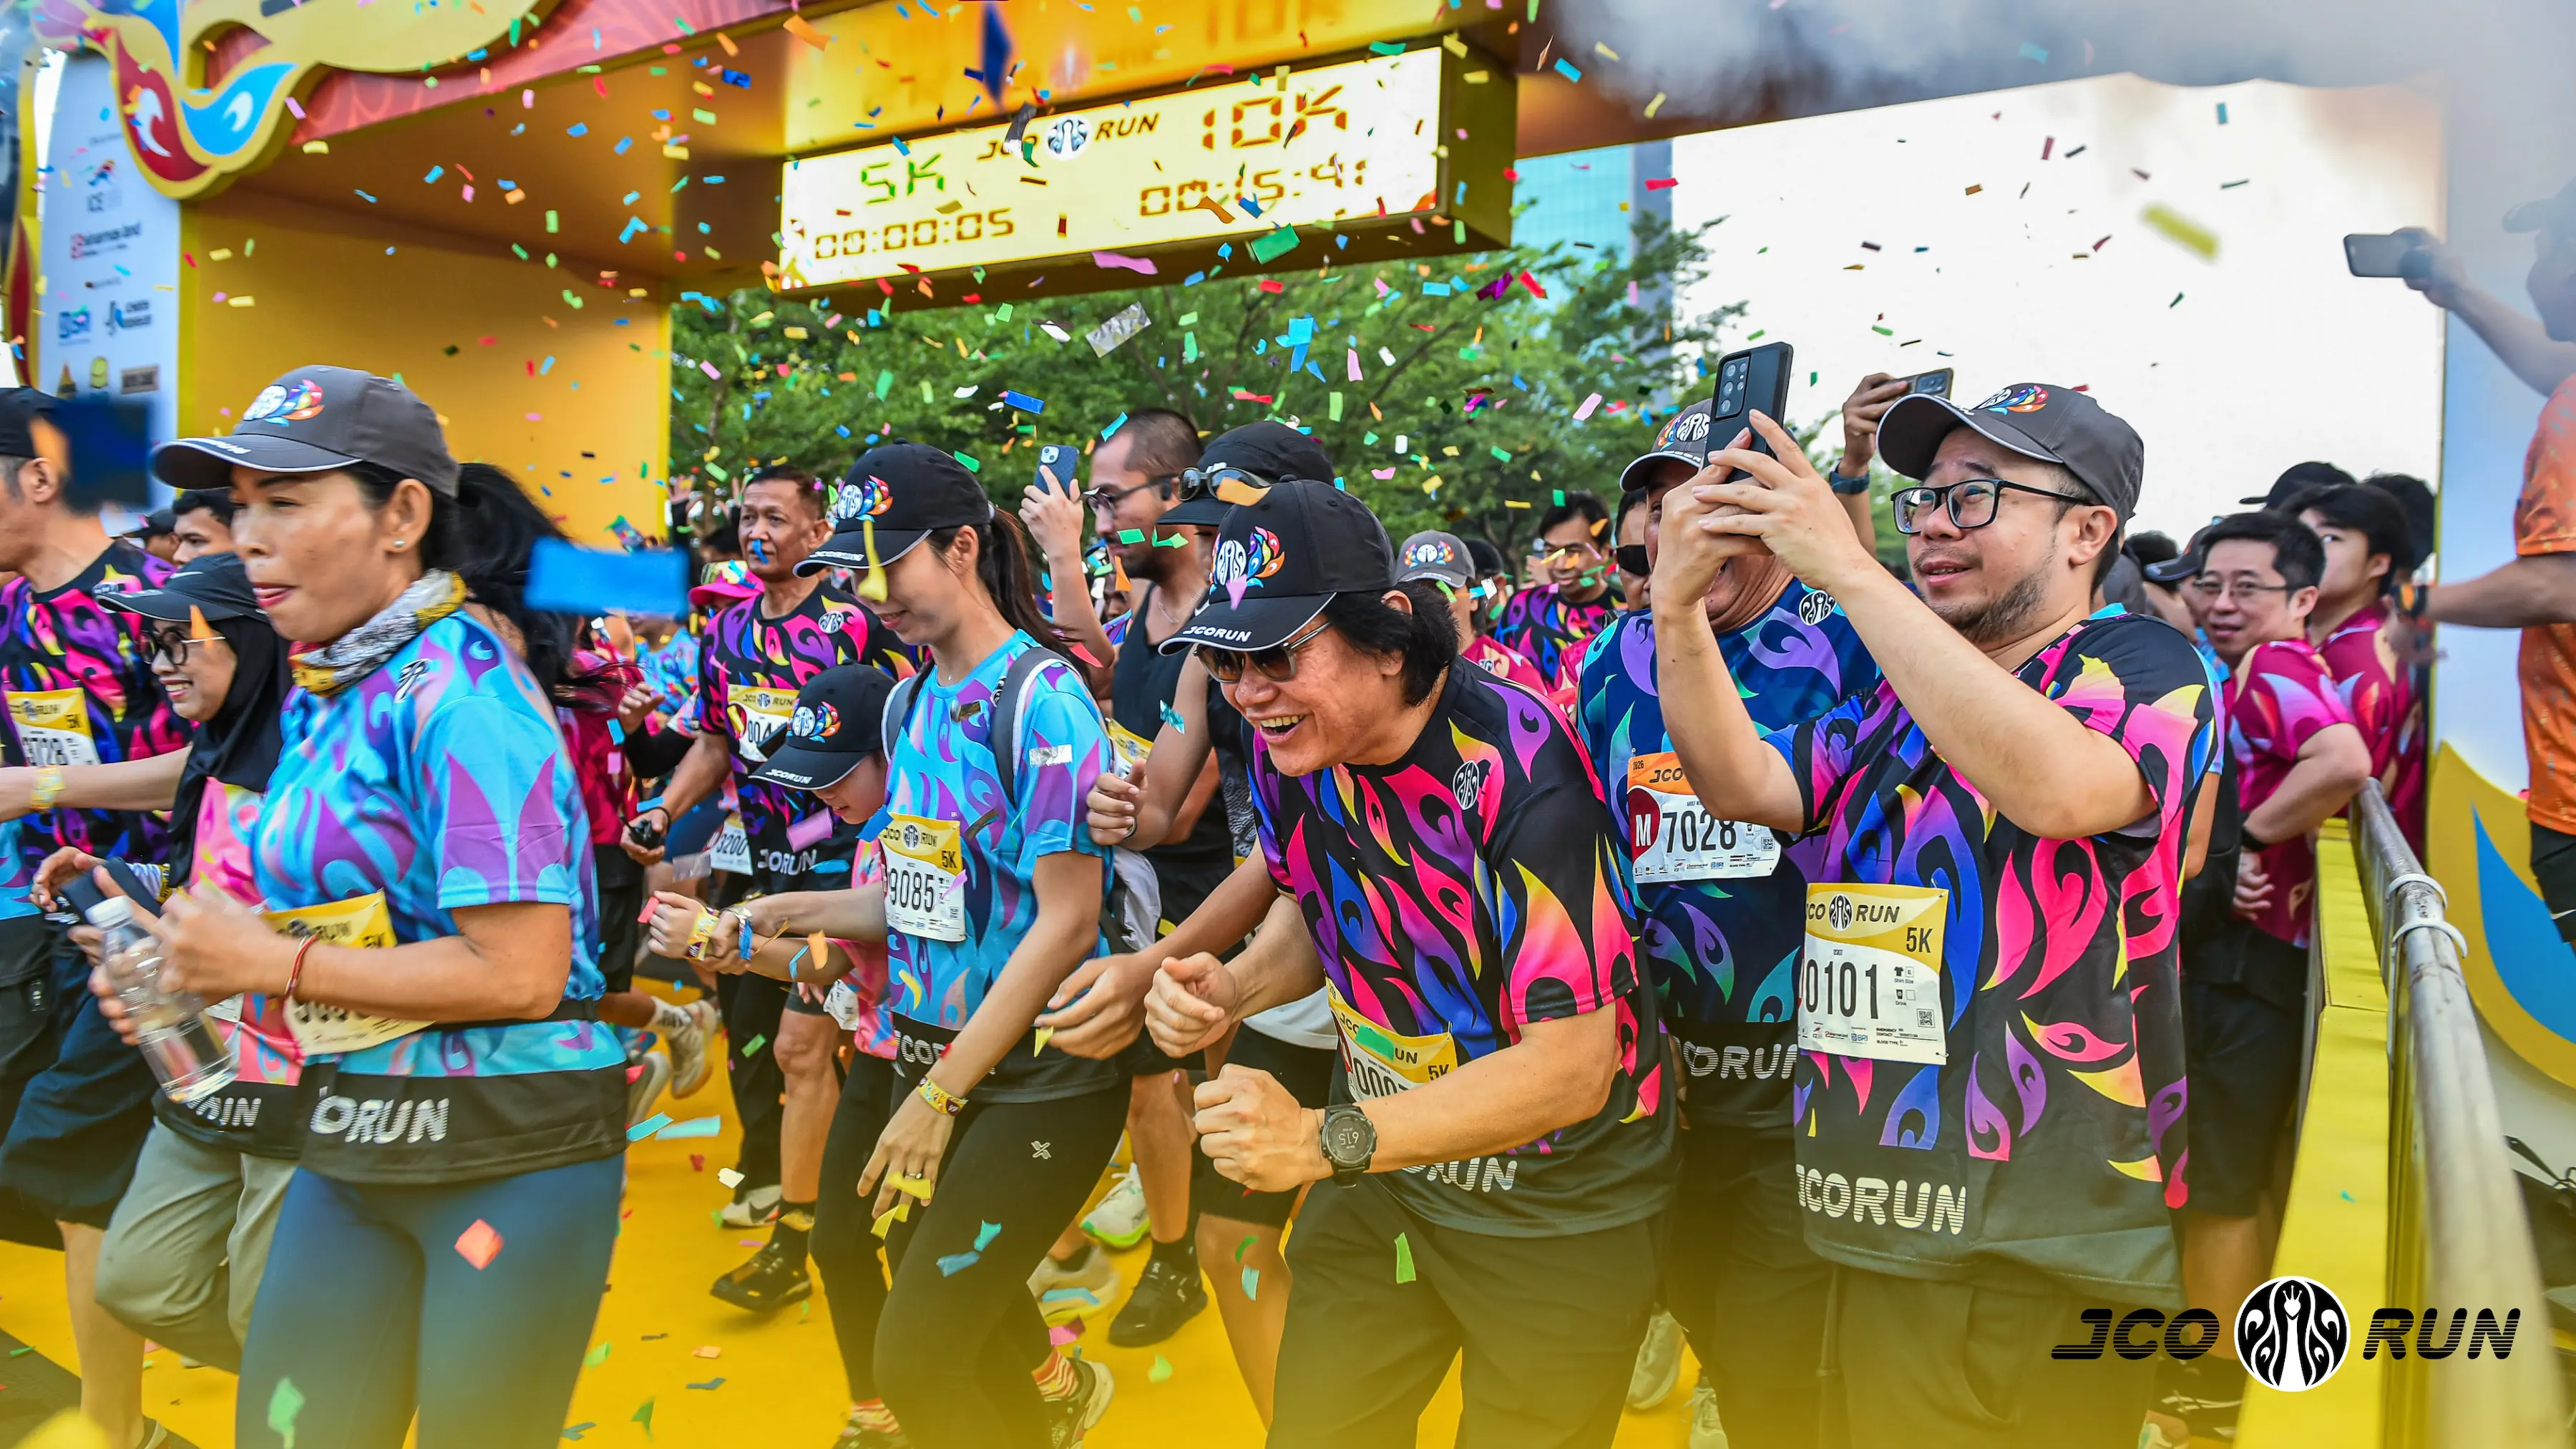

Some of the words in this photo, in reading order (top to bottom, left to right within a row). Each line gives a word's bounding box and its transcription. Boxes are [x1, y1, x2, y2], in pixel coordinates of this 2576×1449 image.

[1095, 112, 1160, 142] RUN
[1203, 85, 1347, 149] 10K
[861, 152, 945, 205] 5K
[1139, 153, 1366, 217] 00:15:41
[814, 208, 1015, 260] 00:00:05
[1182, 625, 1252, 643] JCORUN
[765, 769, 813, 784] JCORUN
[1649, 767, 1685, 784] JCO
[1635, 813, 1652, 847] M
[1662, 810, 1737, 854] 7028
[942, 850, 957, 869] 5K
[889, 868, 934, 913] 9085
[1807, 903, 1826, 920] CO
[1855, 904, 1901, 923] RUN
[1906, 927, 1933, 953] 5K
[1805, 959, 1879, 1020] 0101
[1340, 1012, 1360, 1035] JCO
[1395, 1046, 1418, 1065] UN
[1352, 1057, 1410, 1098] 000
[1428, 1063, 1450, 1082] 5K
[310, 1085, 450, 1144] ORUN
